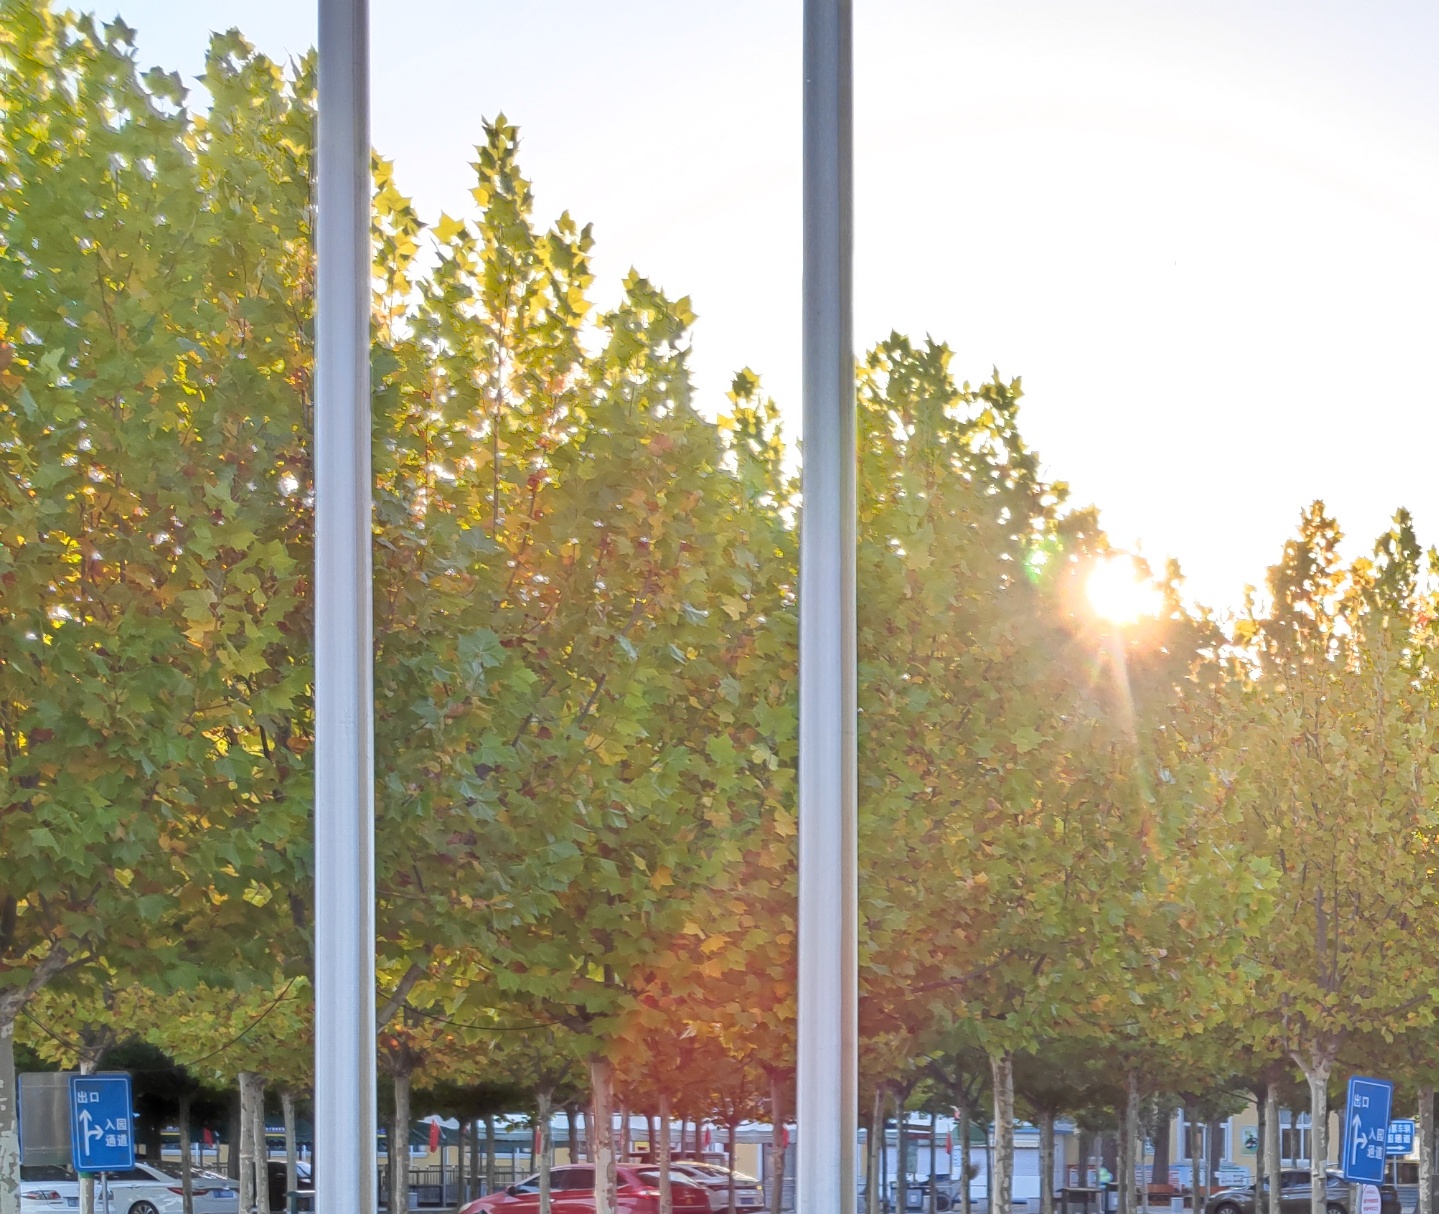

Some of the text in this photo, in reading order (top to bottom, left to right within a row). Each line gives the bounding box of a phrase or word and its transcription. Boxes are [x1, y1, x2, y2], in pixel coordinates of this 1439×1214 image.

[77, 1091, 99, 1103] 出口
[1353, 1094, 1369, 1108] 出口
[105, 1118, 127, 1130] 入园
[105, 1134, 128, 1146] 通道
[1367, 1144, 1383, 1159] 通道
